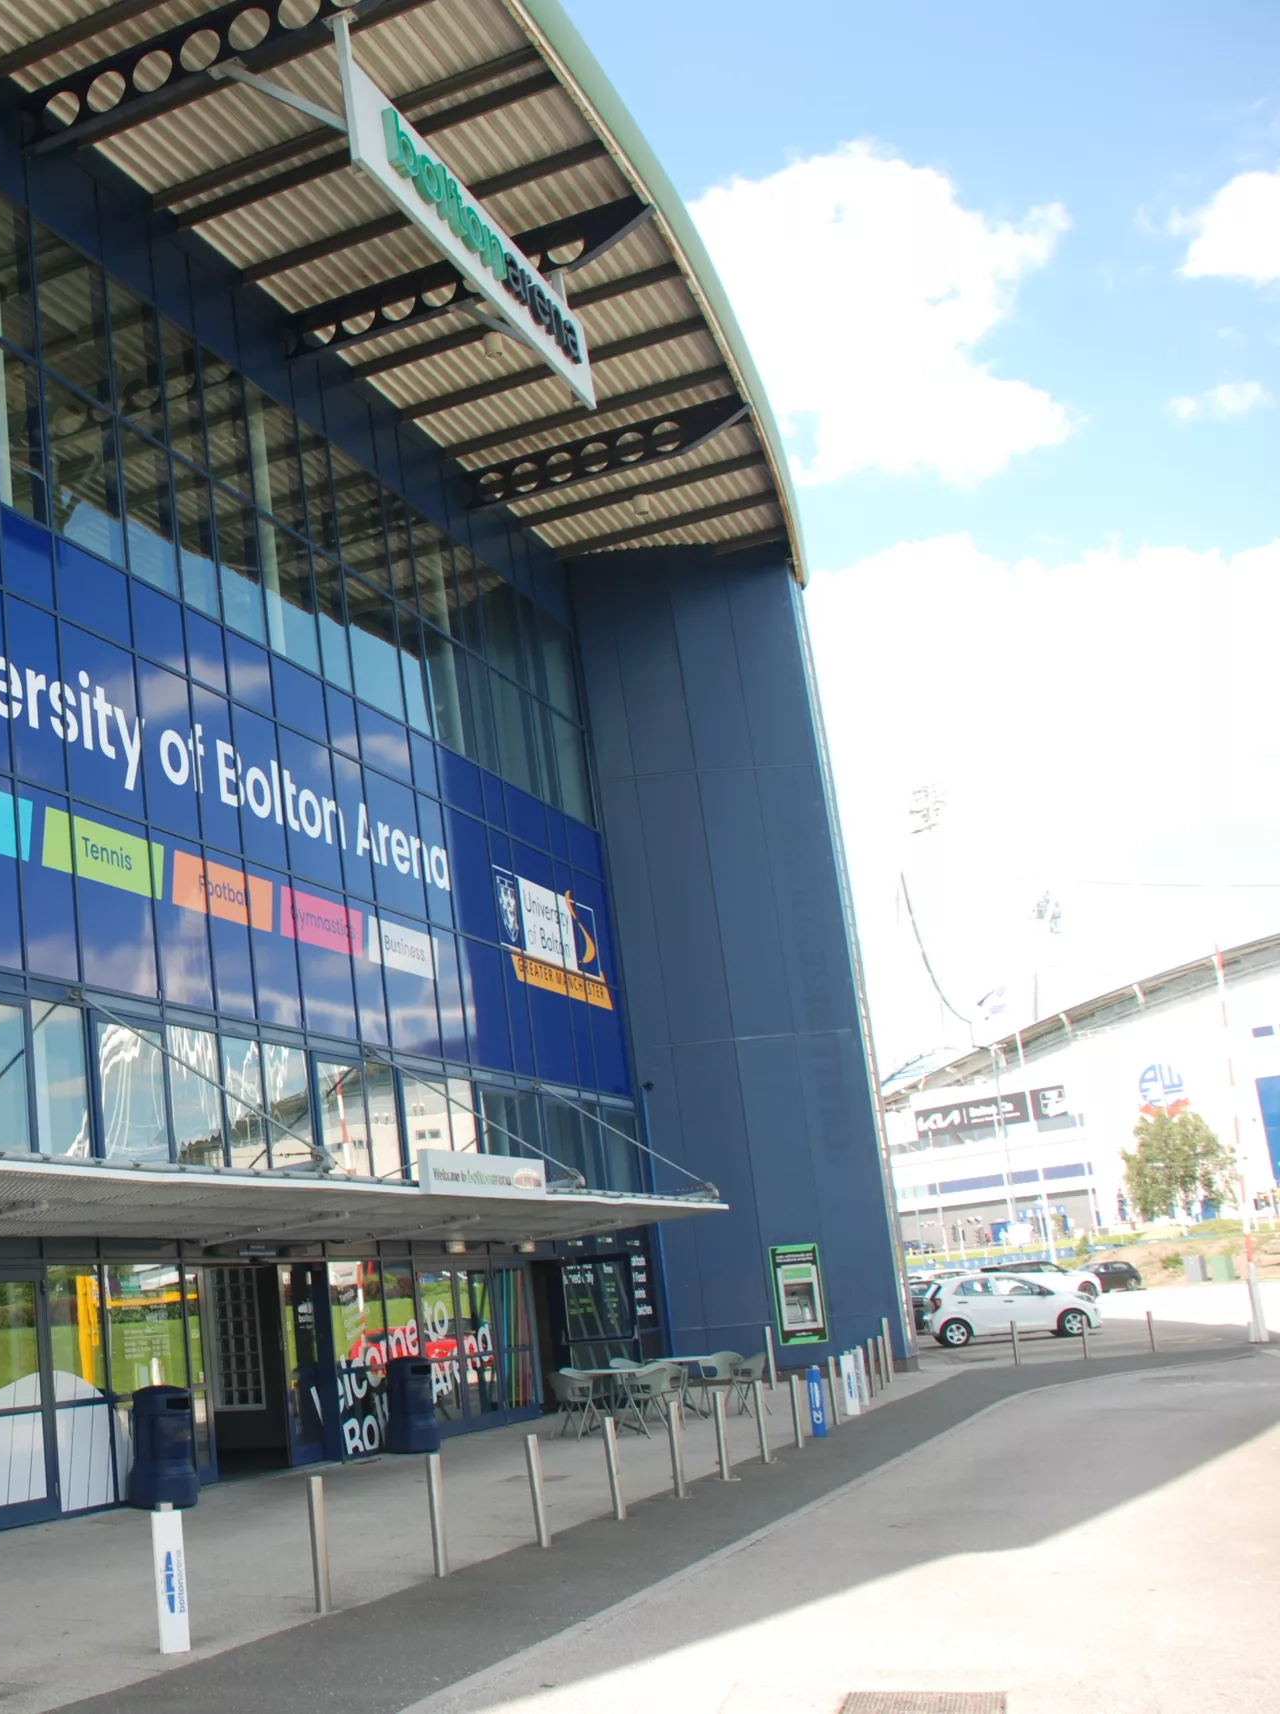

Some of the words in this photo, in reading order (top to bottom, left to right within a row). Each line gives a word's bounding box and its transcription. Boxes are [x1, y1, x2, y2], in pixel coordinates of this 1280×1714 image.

[160, 723, 205, 794] of
[215, 738, 347, 850] Bolton
[356, 802, 451, 892] Arena
[81, 836, 133, 871] Tennis
[198, 874, 248, 906] Footba
[523, 888, 570, 935] Universty
[384, 934, 426, 962] Business
[527, 923, 538, 946] of
[517, 958, 554, 982] GREATER
[555, 970, 605, 1000] MANCHSTER
[423, 1300, 449, 1342] to
